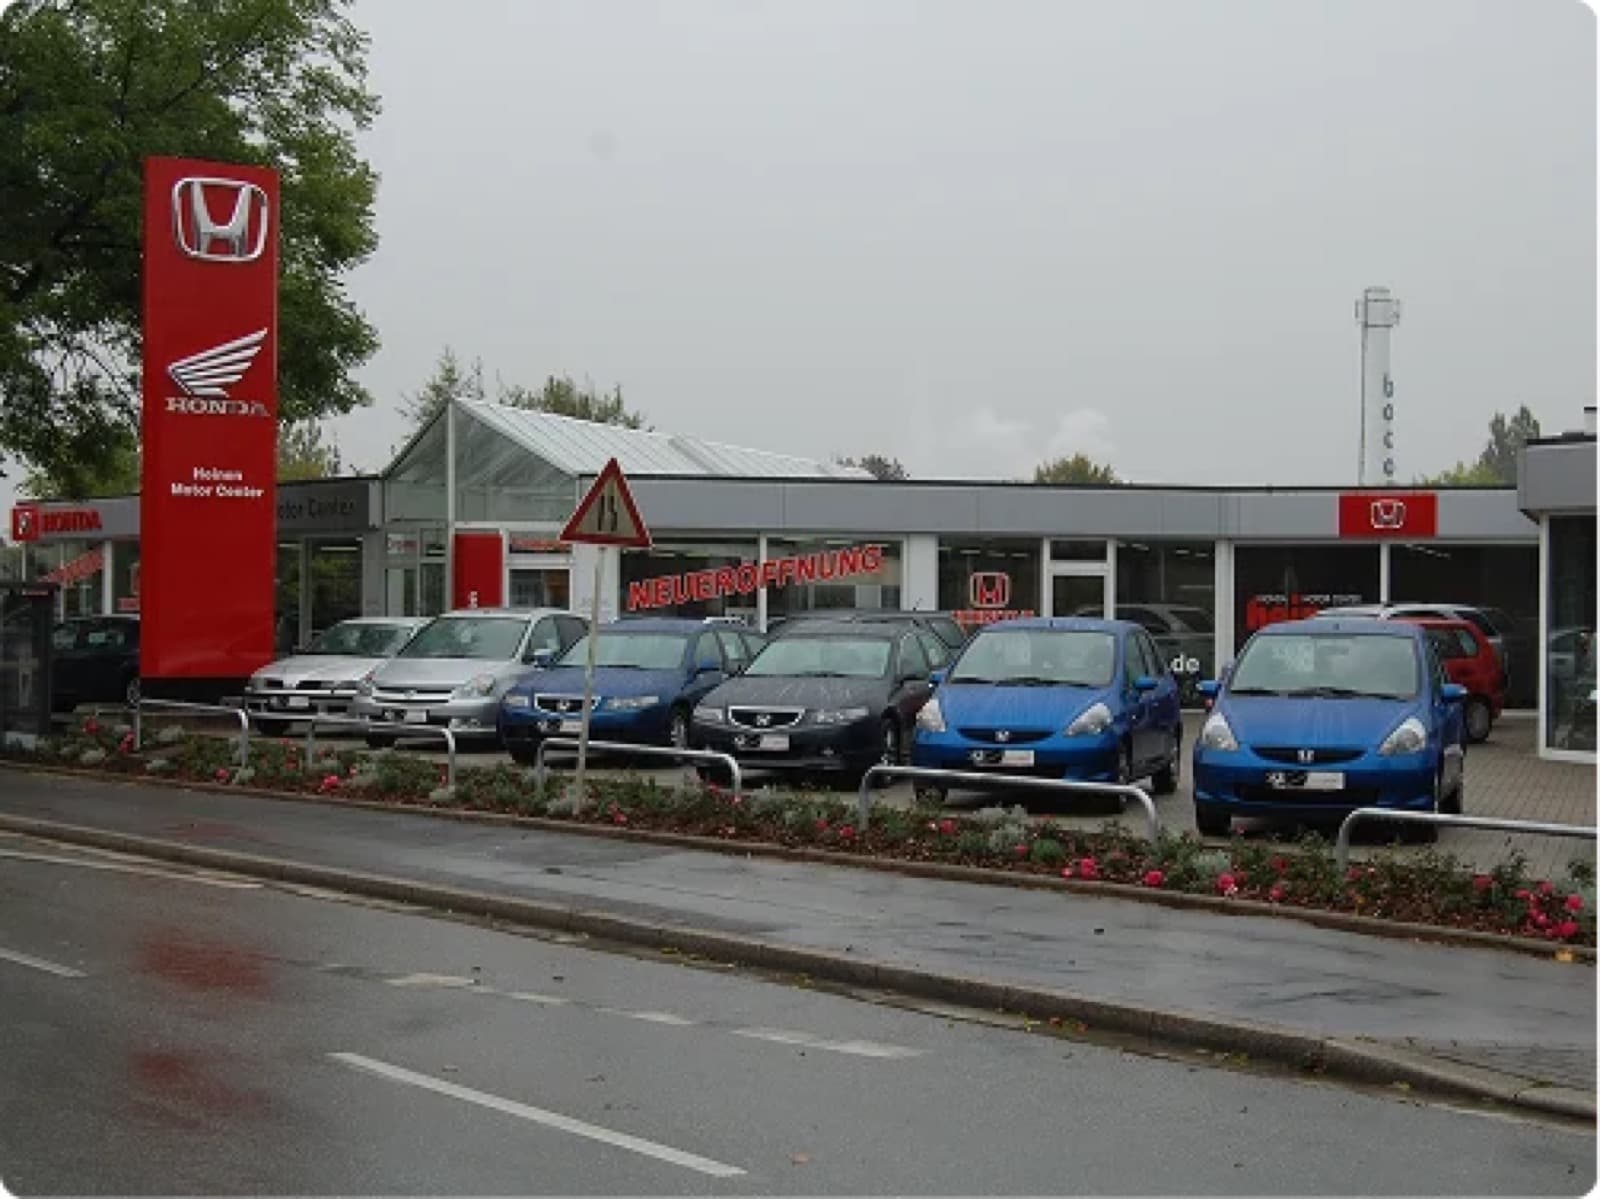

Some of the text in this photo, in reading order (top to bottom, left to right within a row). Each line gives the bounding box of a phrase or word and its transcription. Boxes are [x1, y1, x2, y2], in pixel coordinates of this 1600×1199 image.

[165, 397, 271, 417] HONDA
[171, 482, 264, 498] Motor Center
[277, 499, 303, 519] otor
